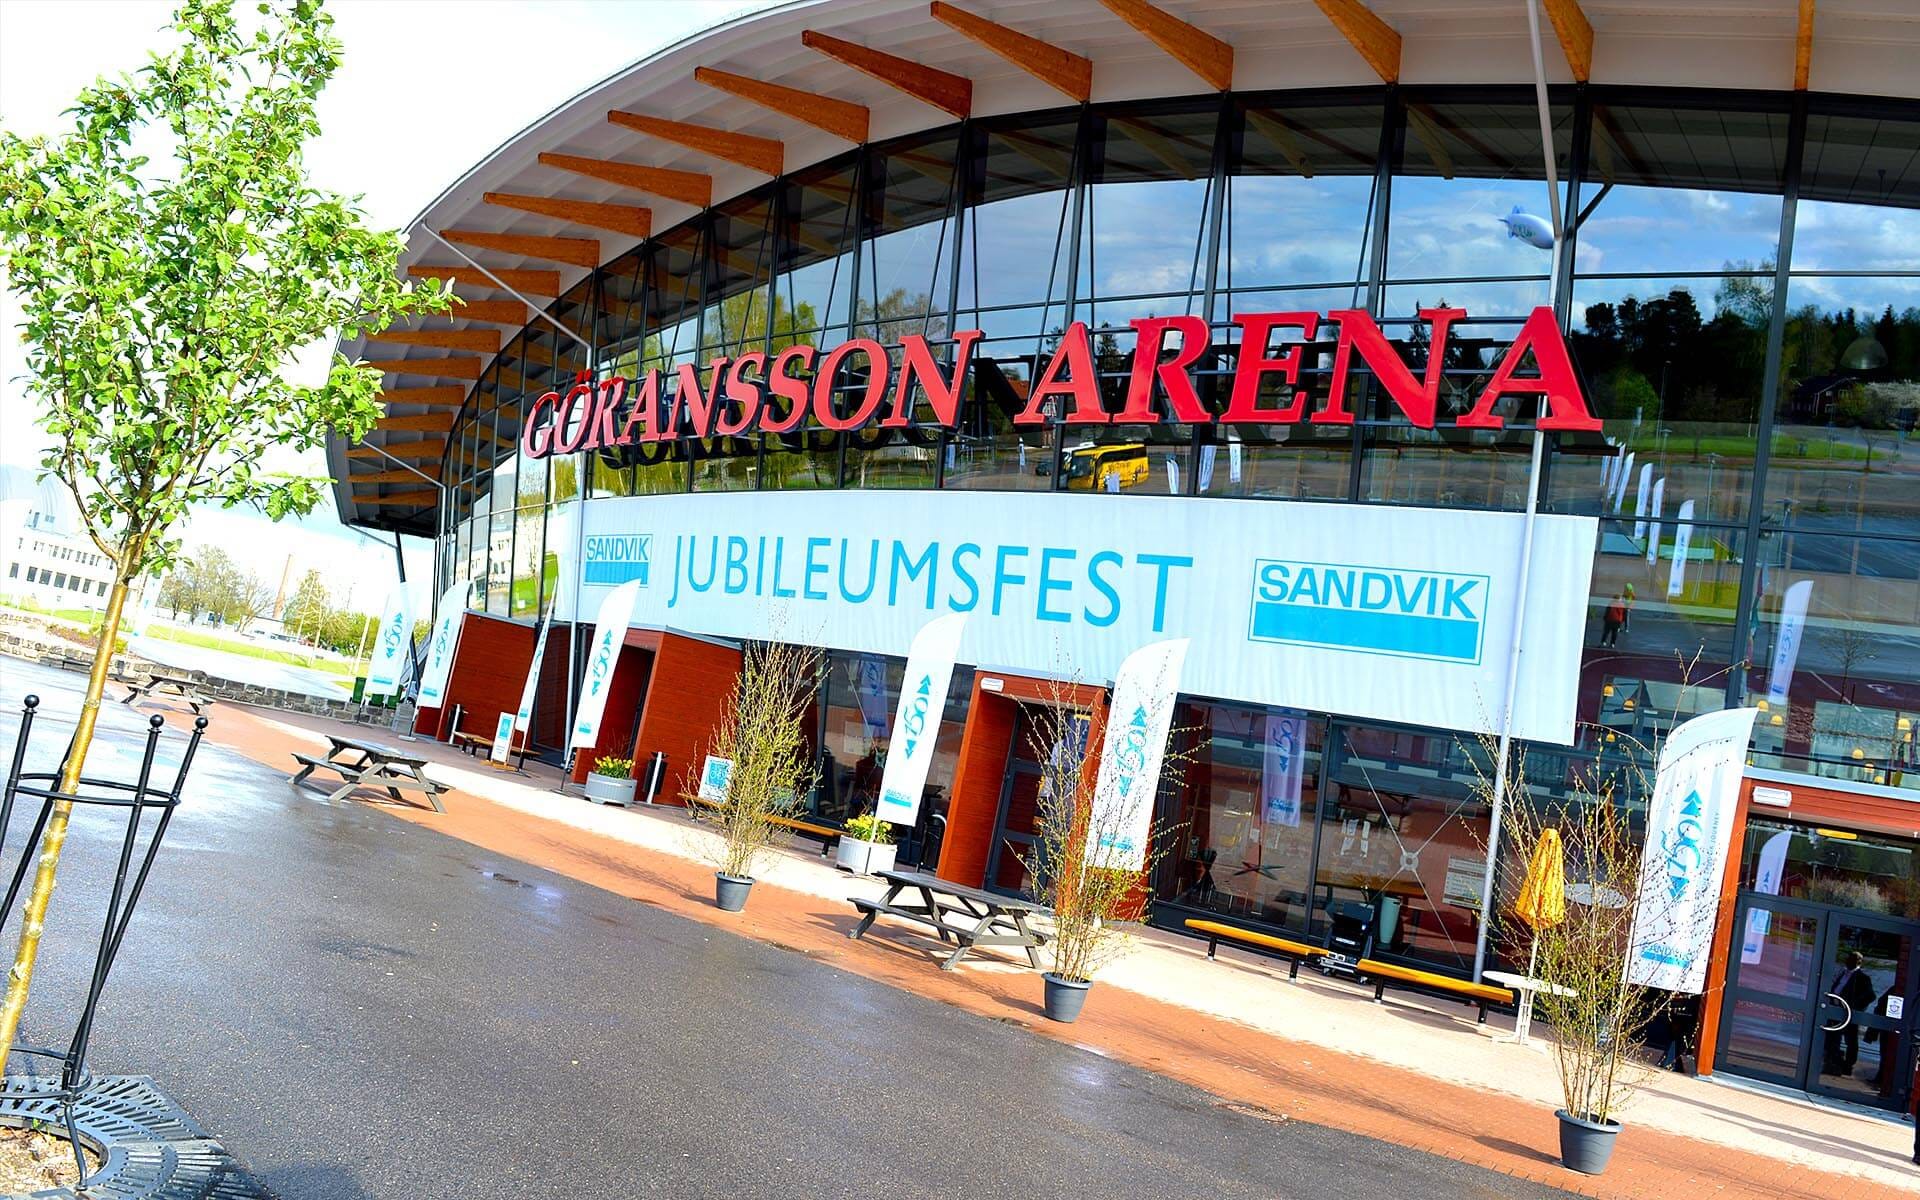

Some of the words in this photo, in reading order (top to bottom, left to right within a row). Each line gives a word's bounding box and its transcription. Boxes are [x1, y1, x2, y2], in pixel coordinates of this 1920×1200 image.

[524, 330, 984, 457] GÖRANSSON
[1013, 306, 1605, 431] ARENA
[587, 537, 650, 560] SANDVIK
[668, 535, 1194, 632] JUBILEUMSFEST
[1259, 564, 1478, 619] SANDVIK
